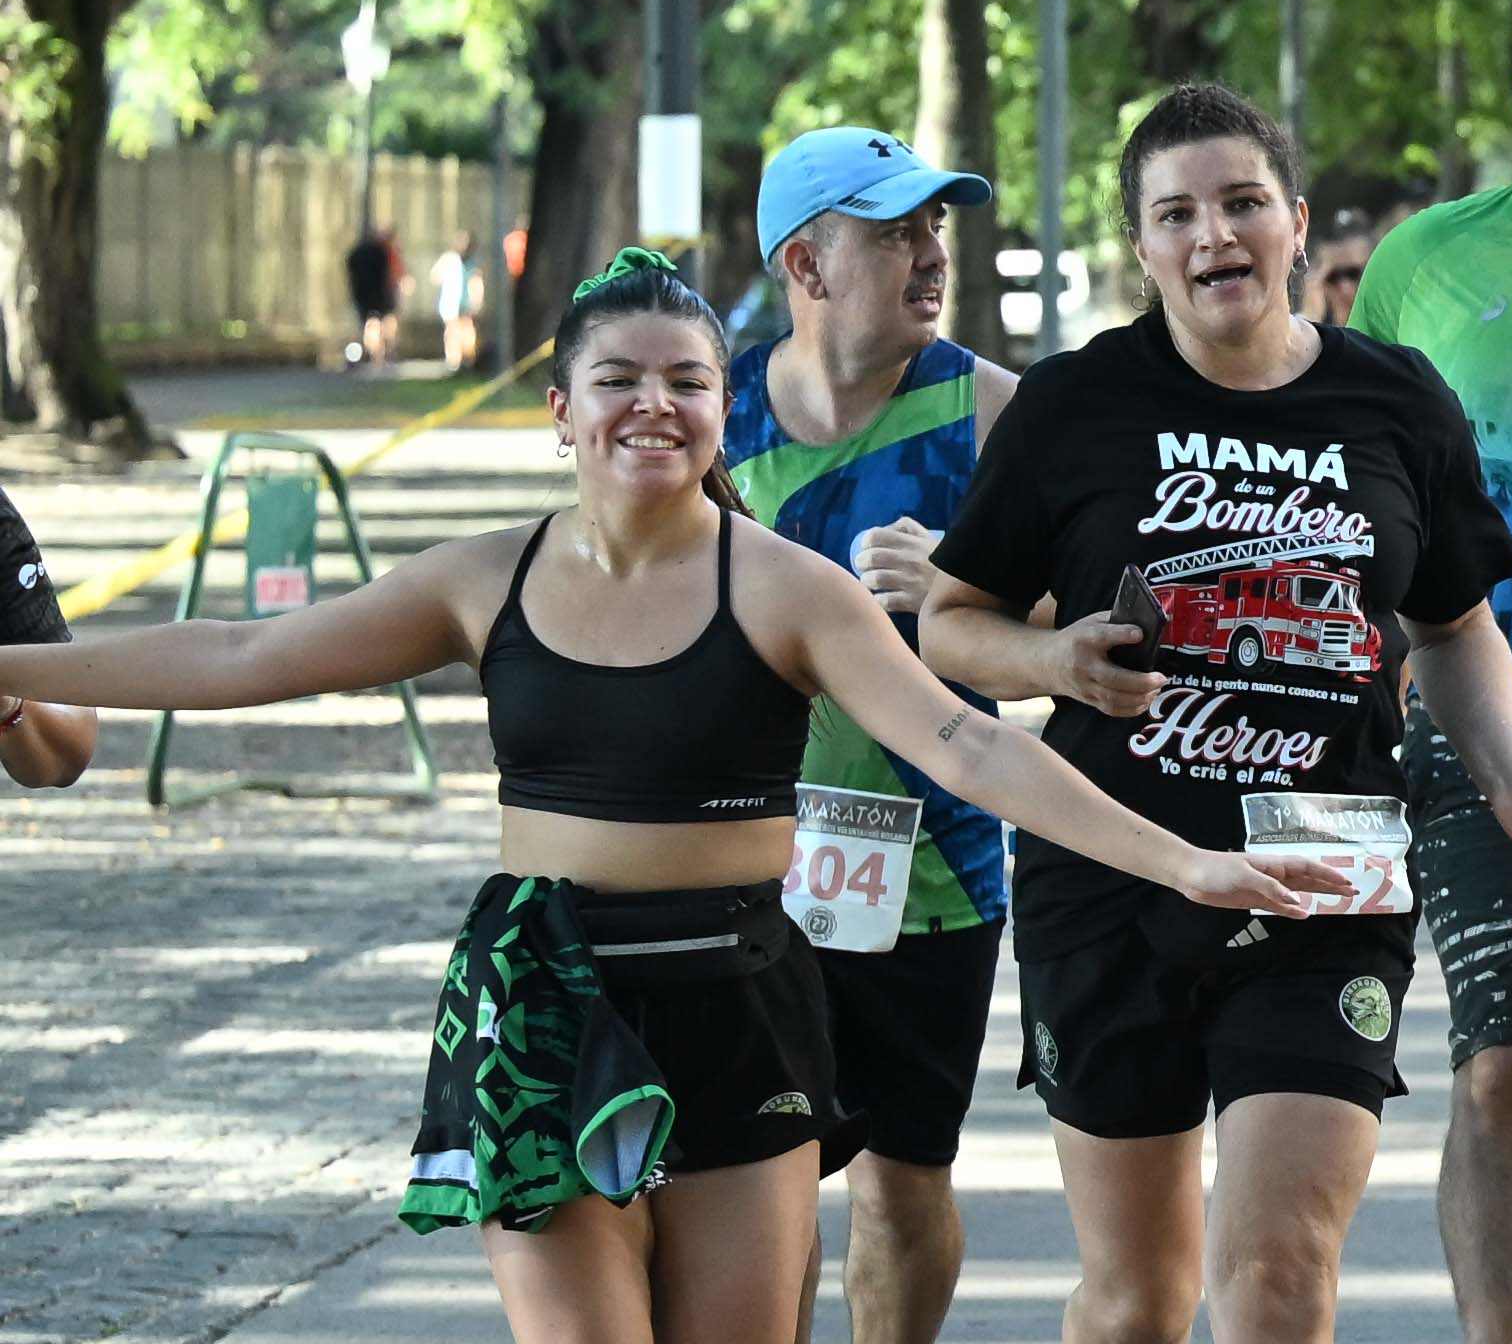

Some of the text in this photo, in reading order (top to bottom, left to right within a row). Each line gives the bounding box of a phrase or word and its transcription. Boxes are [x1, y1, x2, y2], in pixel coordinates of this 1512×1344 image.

[1157, 432, 1349, 490] MAMÁ
[1234, 477, 1276, 495] de un
[1138, 471, 1372, 541] Bombero
[1185, 674, 1199, 686] de
[1202, 675, 1212, 687] la
[1215, 676, 1249, 692] gente
[1251, 682, 1285, 694] nunca
[1288, 685, 1328, 700] conoce
[1331, 692, 1337, 701] a
[1339, 694, 1358, 704] sus
[1128, 687, 1332, 772] Heroes
[1160, 757, 1294, 787] Yo crié el mío.
[799, 799, 896, 827] MARATÓN
[1299, 804, 1385, 830] MARATÓN
